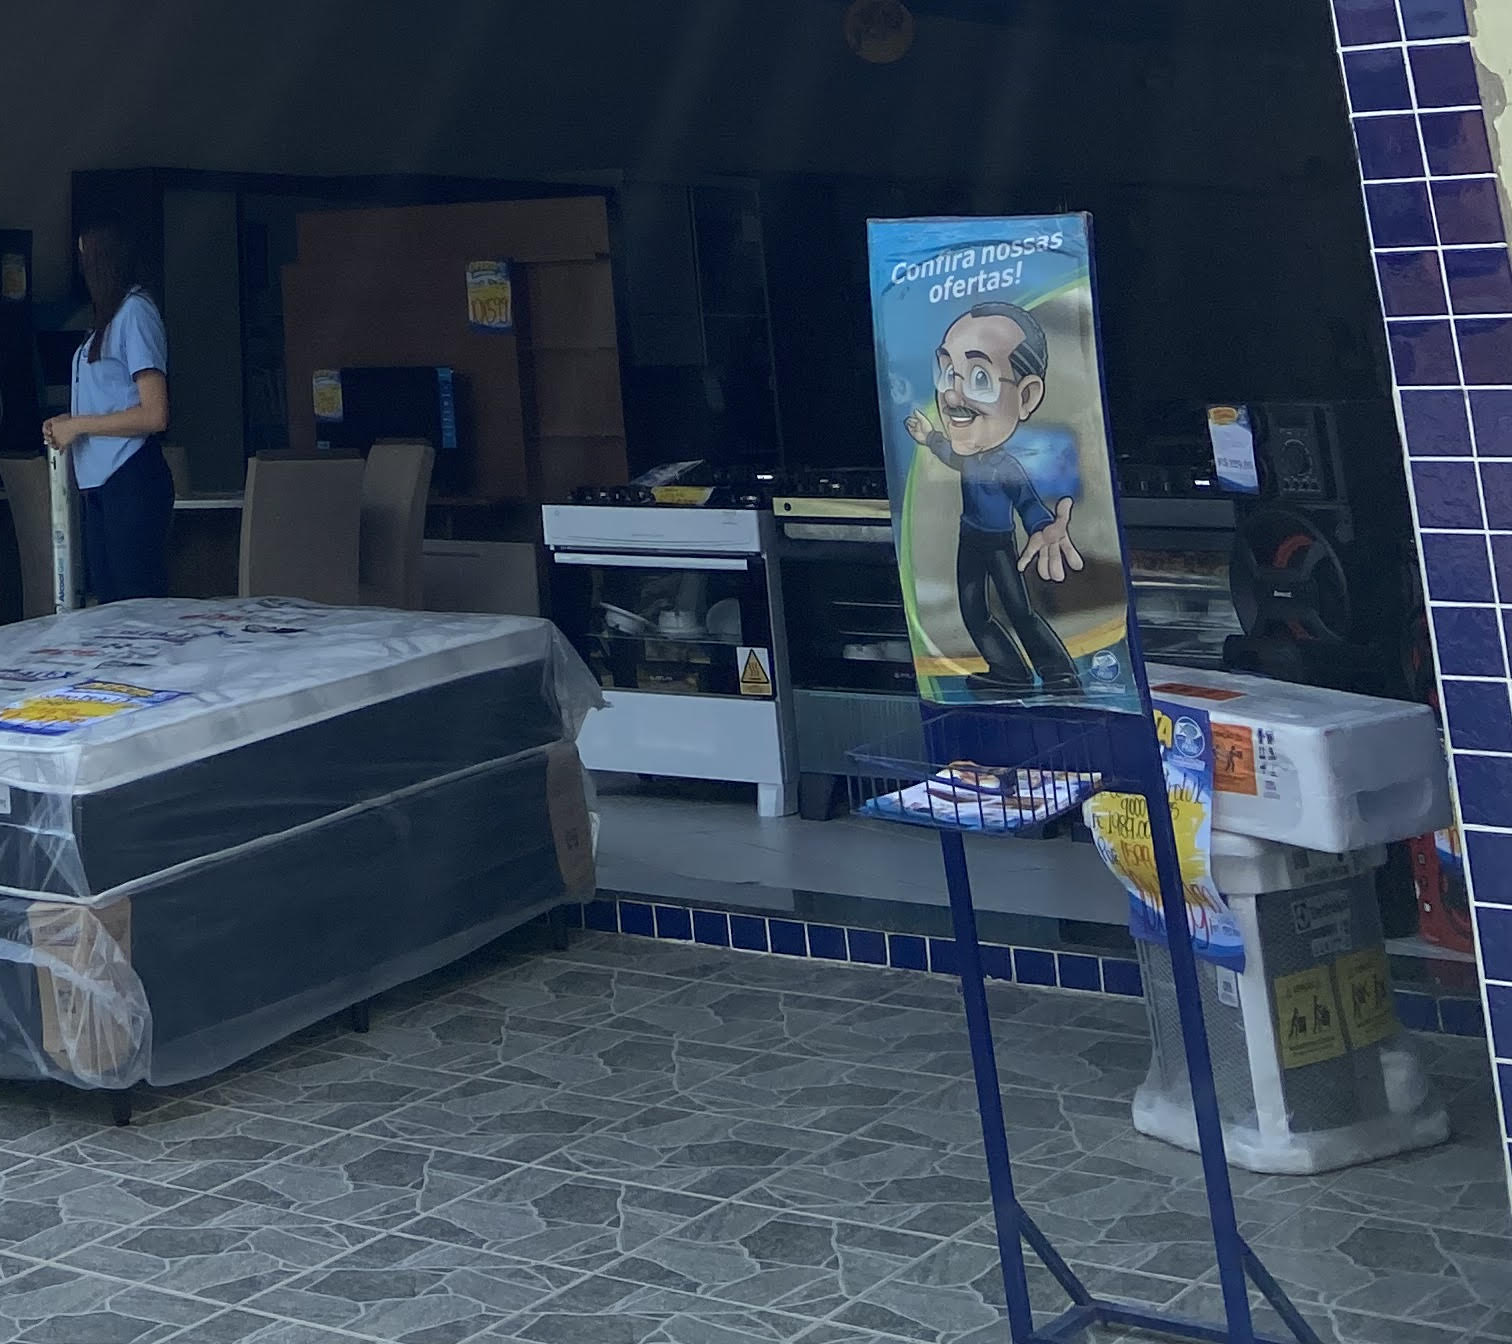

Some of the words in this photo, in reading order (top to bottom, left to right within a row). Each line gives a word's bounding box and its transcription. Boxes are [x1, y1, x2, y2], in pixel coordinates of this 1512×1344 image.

[891, 248, 976, 286] Confira
[980, 231, 1064, 264] nossas
[929, 261, 1023, 304] ofertas!
